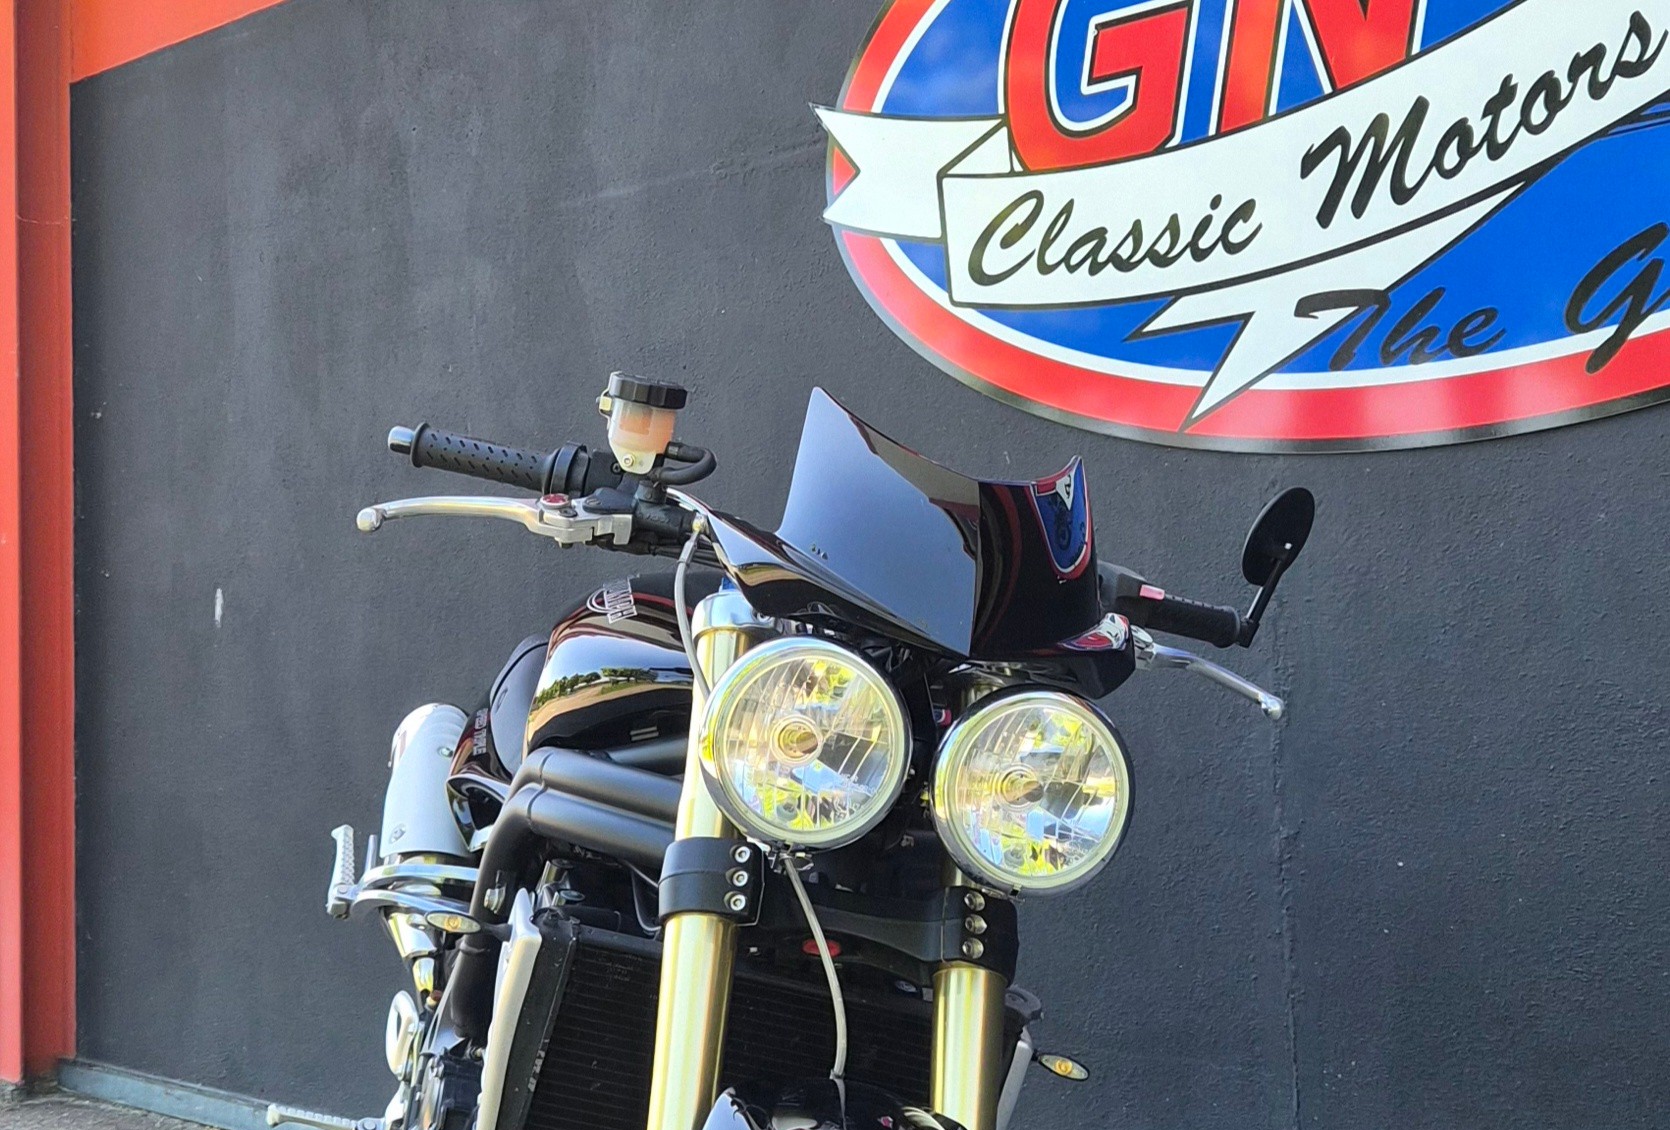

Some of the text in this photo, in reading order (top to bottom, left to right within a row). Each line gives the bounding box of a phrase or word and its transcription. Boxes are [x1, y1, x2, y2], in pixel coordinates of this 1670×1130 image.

[967, 10, 1669, 287] Classic Motors
[1294, 286, 1507, 372] The
